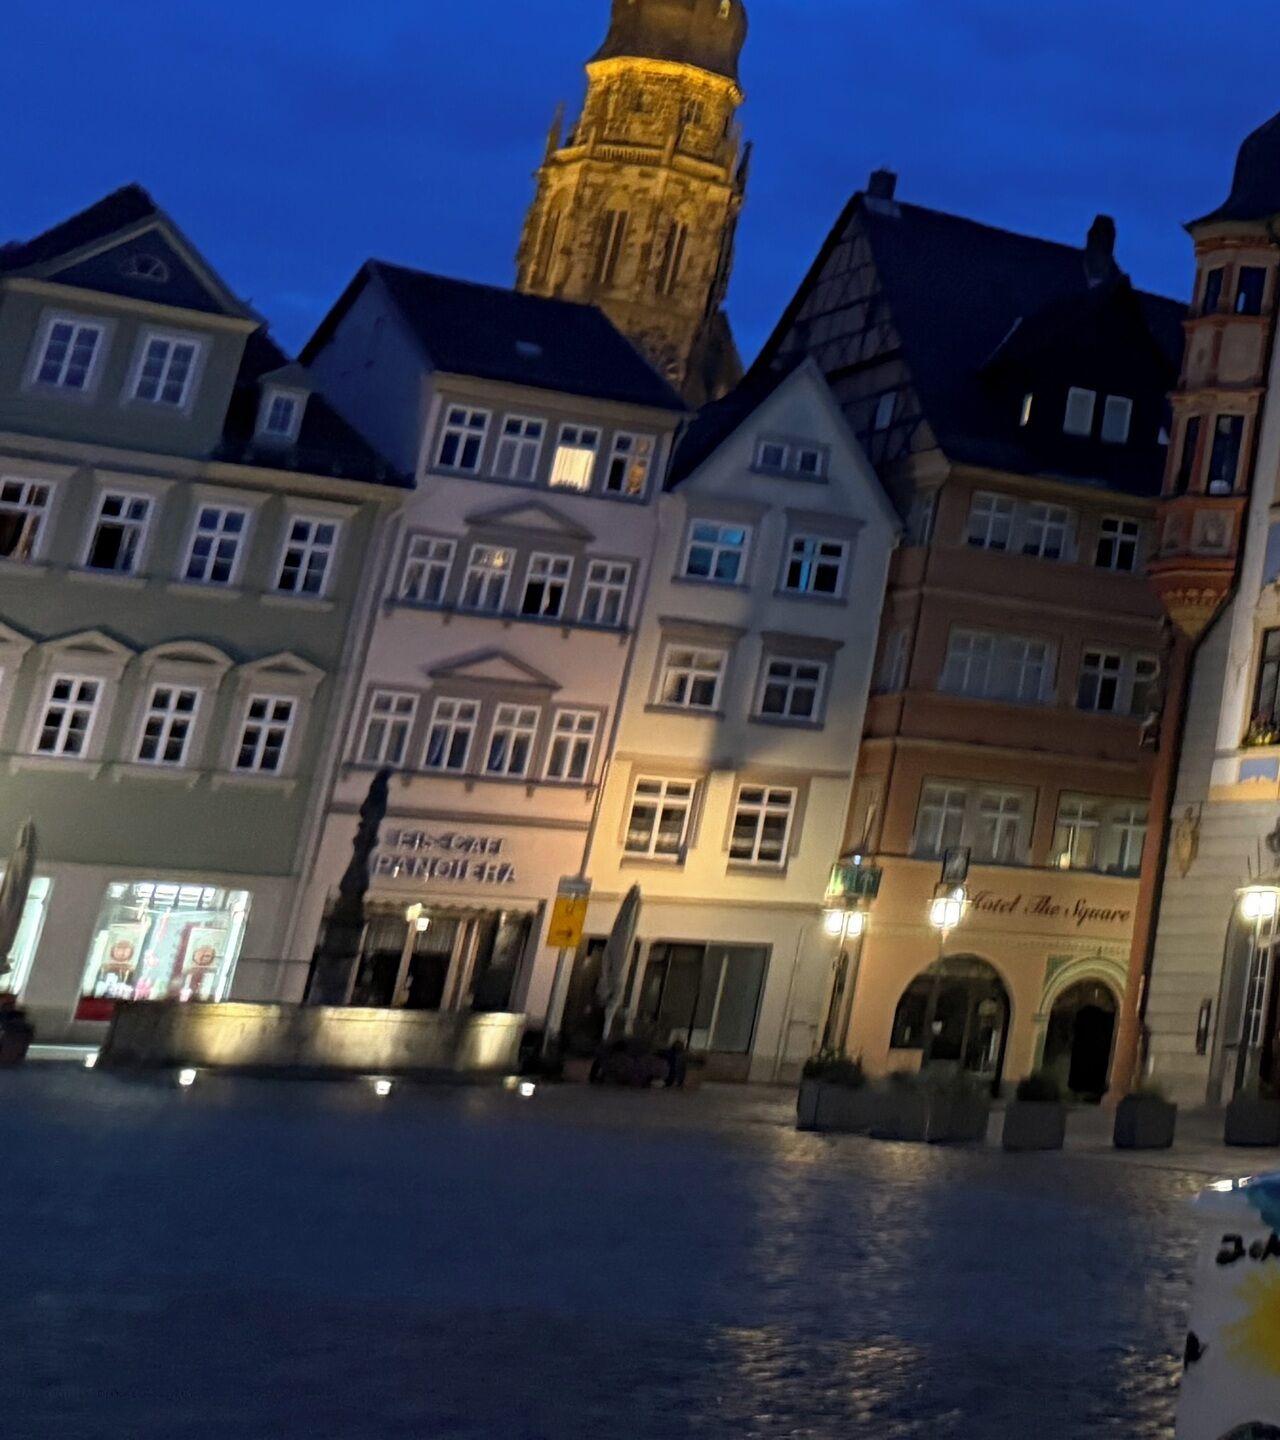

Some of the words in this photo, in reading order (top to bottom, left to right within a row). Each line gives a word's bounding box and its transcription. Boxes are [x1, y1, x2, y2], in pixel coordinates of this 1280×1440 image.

[970, 890, 1022, 912] Hotel
[1024, 895, 1060, 917] The
[1064, 898, 1131, 927] Square
